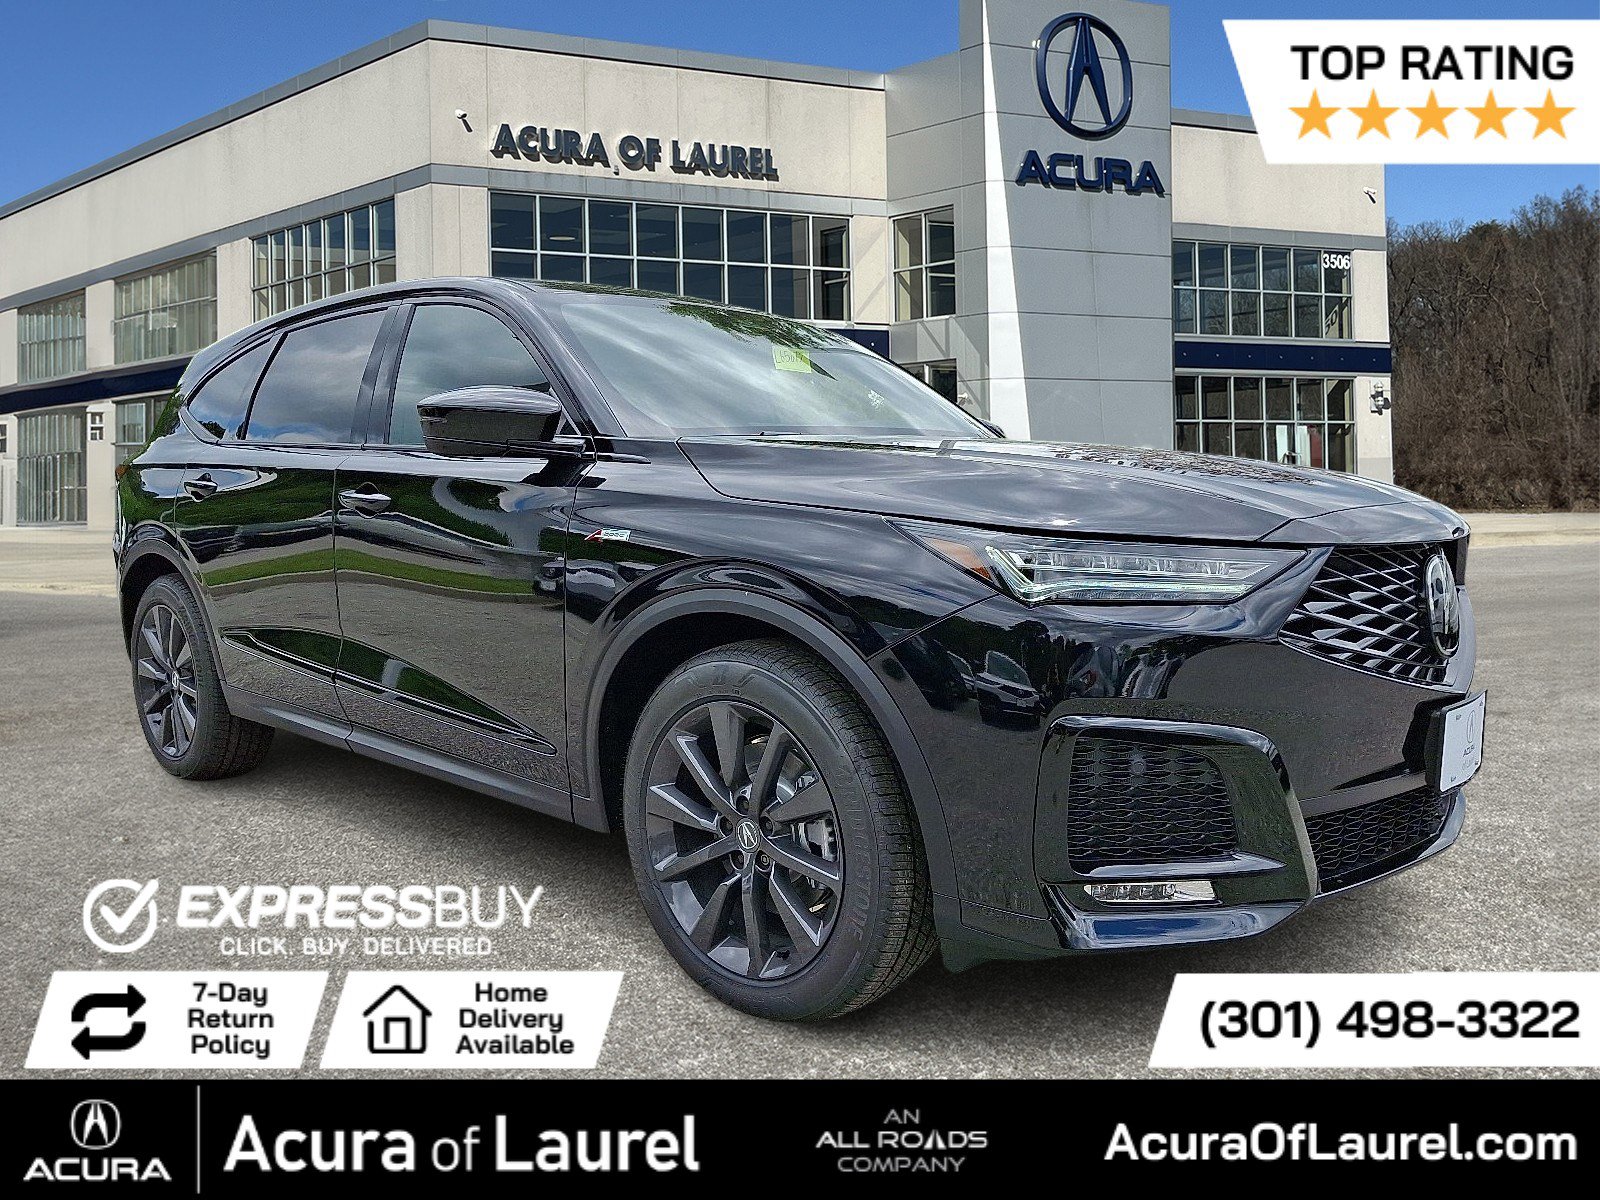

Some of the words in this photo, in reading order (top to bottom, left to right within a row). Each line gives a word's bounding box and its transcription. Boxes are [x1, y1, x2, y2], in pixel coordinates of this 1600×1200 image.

[491, 123, 609, 166] ACURA
[617, 134, 661, 171] OF
[671, 139, 779, 180] LAUREL
[1016, 149, 1166, 197] ACURA
[1321, 252, 1351, 271] 3506
